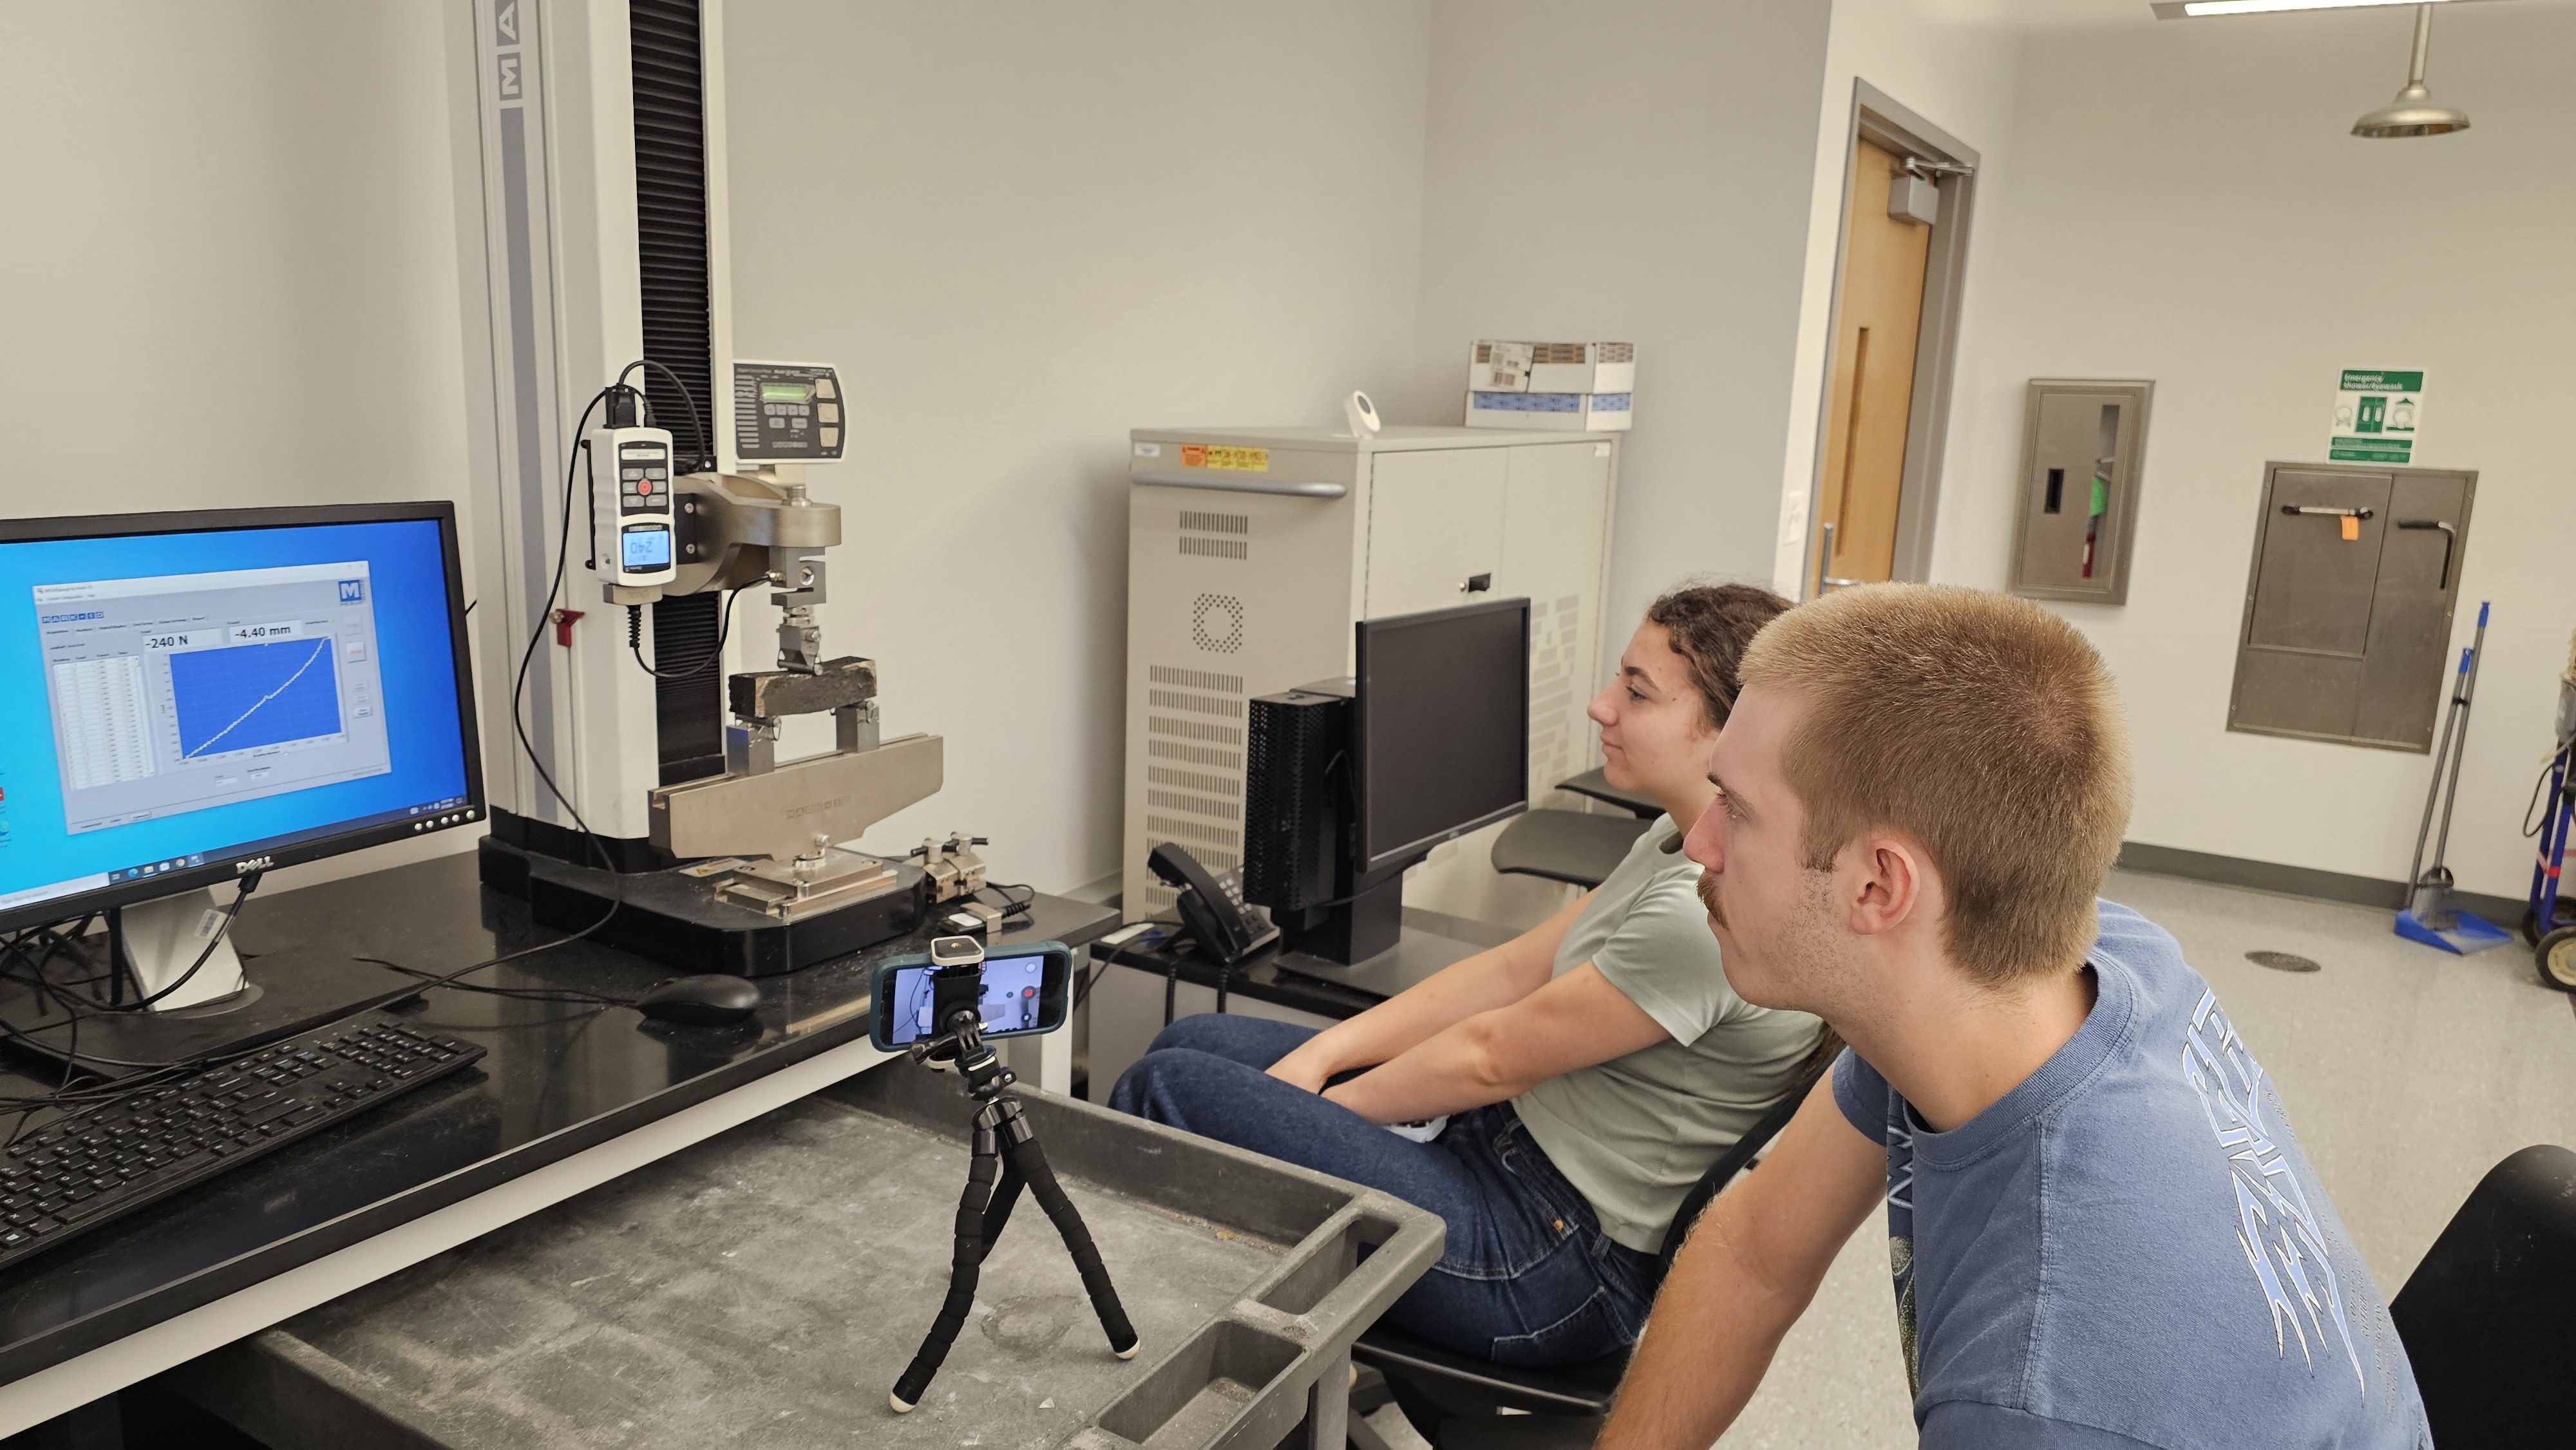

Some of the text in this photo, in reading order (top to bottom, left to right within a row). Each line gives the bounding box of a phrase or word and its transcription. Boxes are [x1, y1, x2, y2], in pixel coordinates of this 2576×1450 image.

[2344, 373, 2384, 384] Emergency
[234, 626, 291, 639] -4.40 mm
[145, 635, 188, 648] -240 N
[236, 856, 274, 875] DELL
